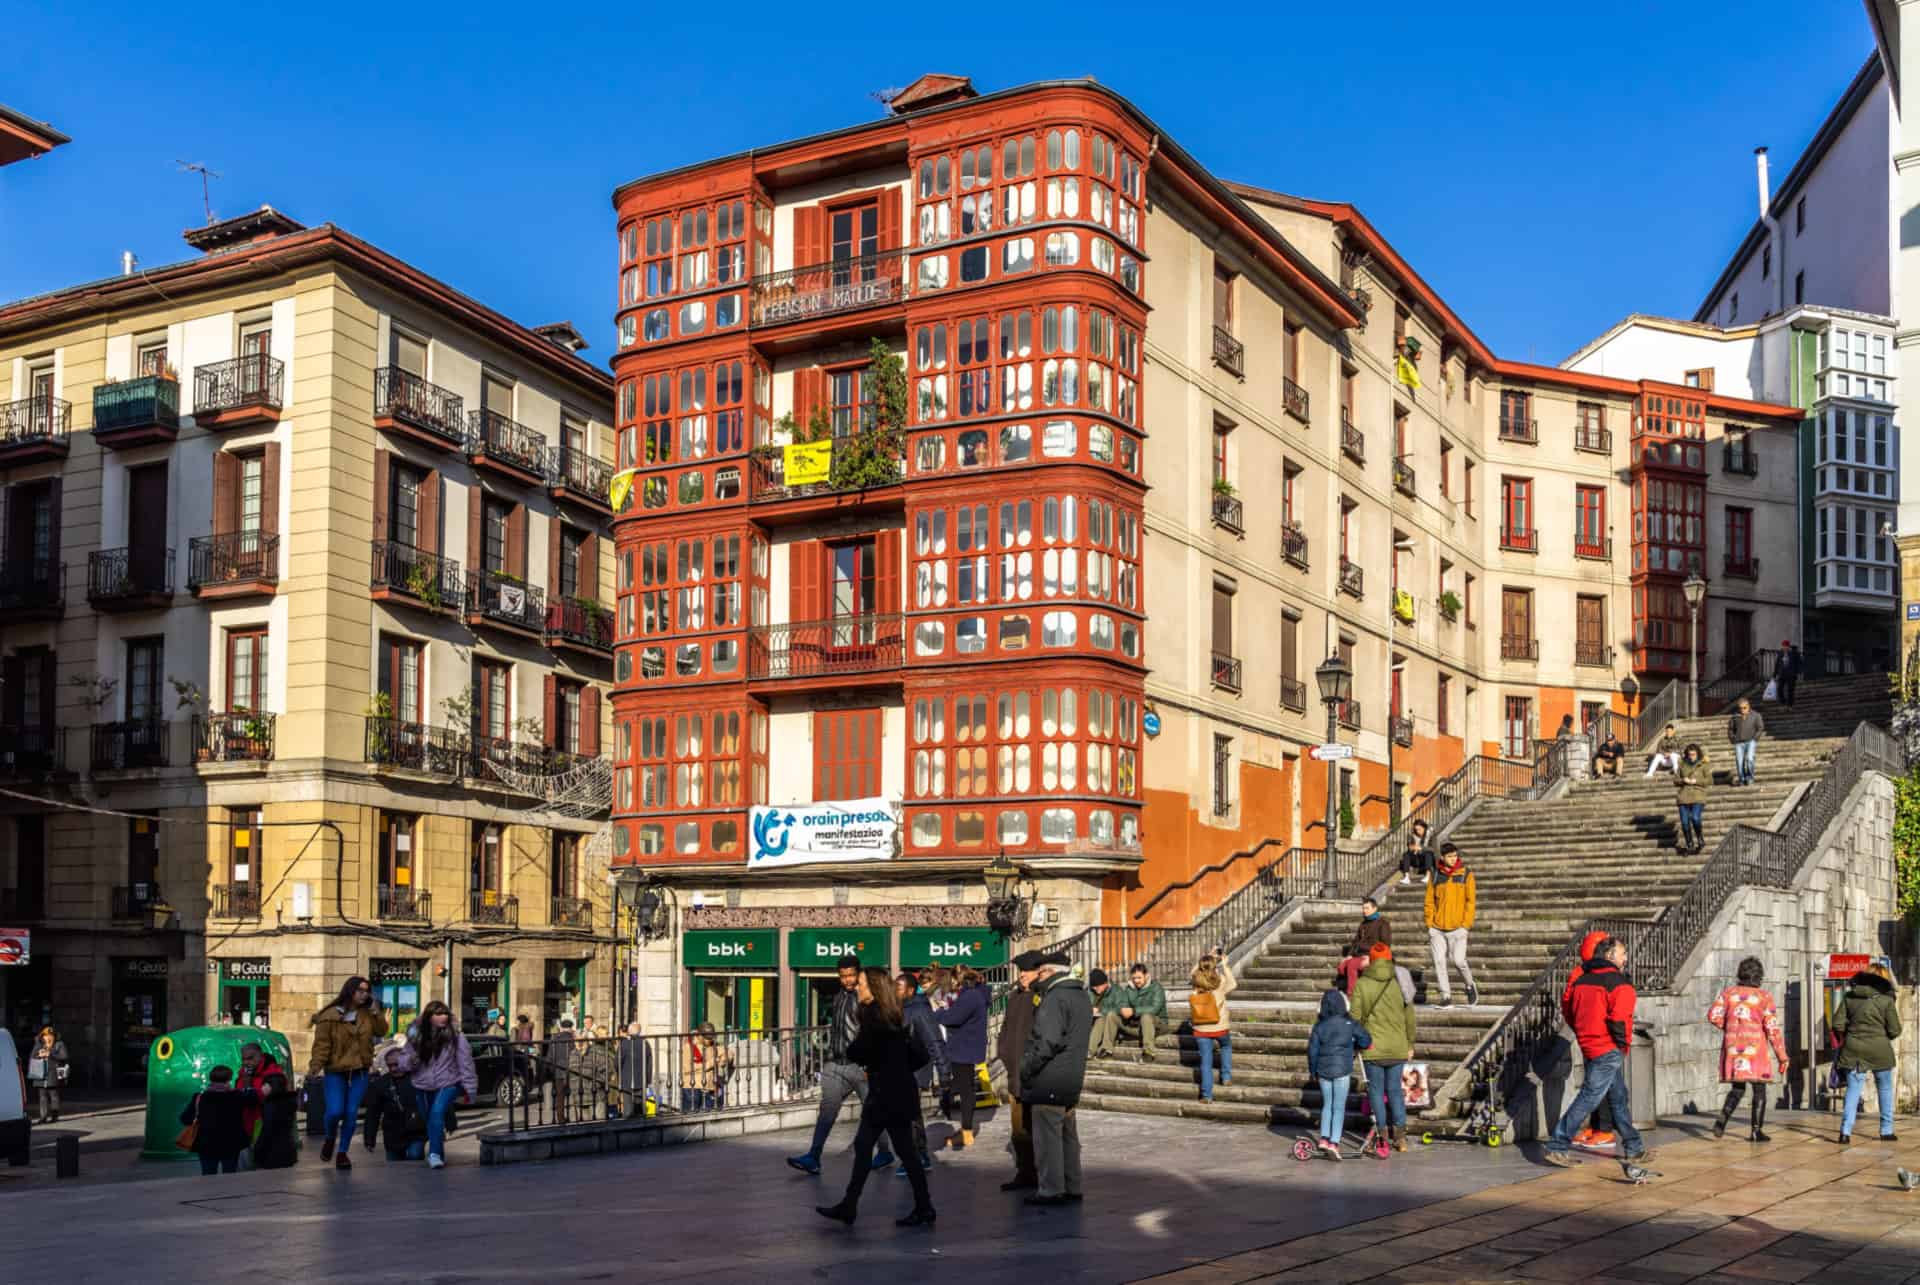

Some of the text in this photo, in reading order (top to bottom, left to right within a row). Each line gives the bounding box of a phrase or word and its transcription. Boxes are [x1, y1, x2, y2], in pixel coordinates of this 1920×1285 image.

[803, 811, 839, 826] orain
[815, 828, 883, 840] manifestazioa
[708, 942, 746, 956] bbk
[816, 942, 857, 956] bbk
[929, 941, 973, 956] bbk
